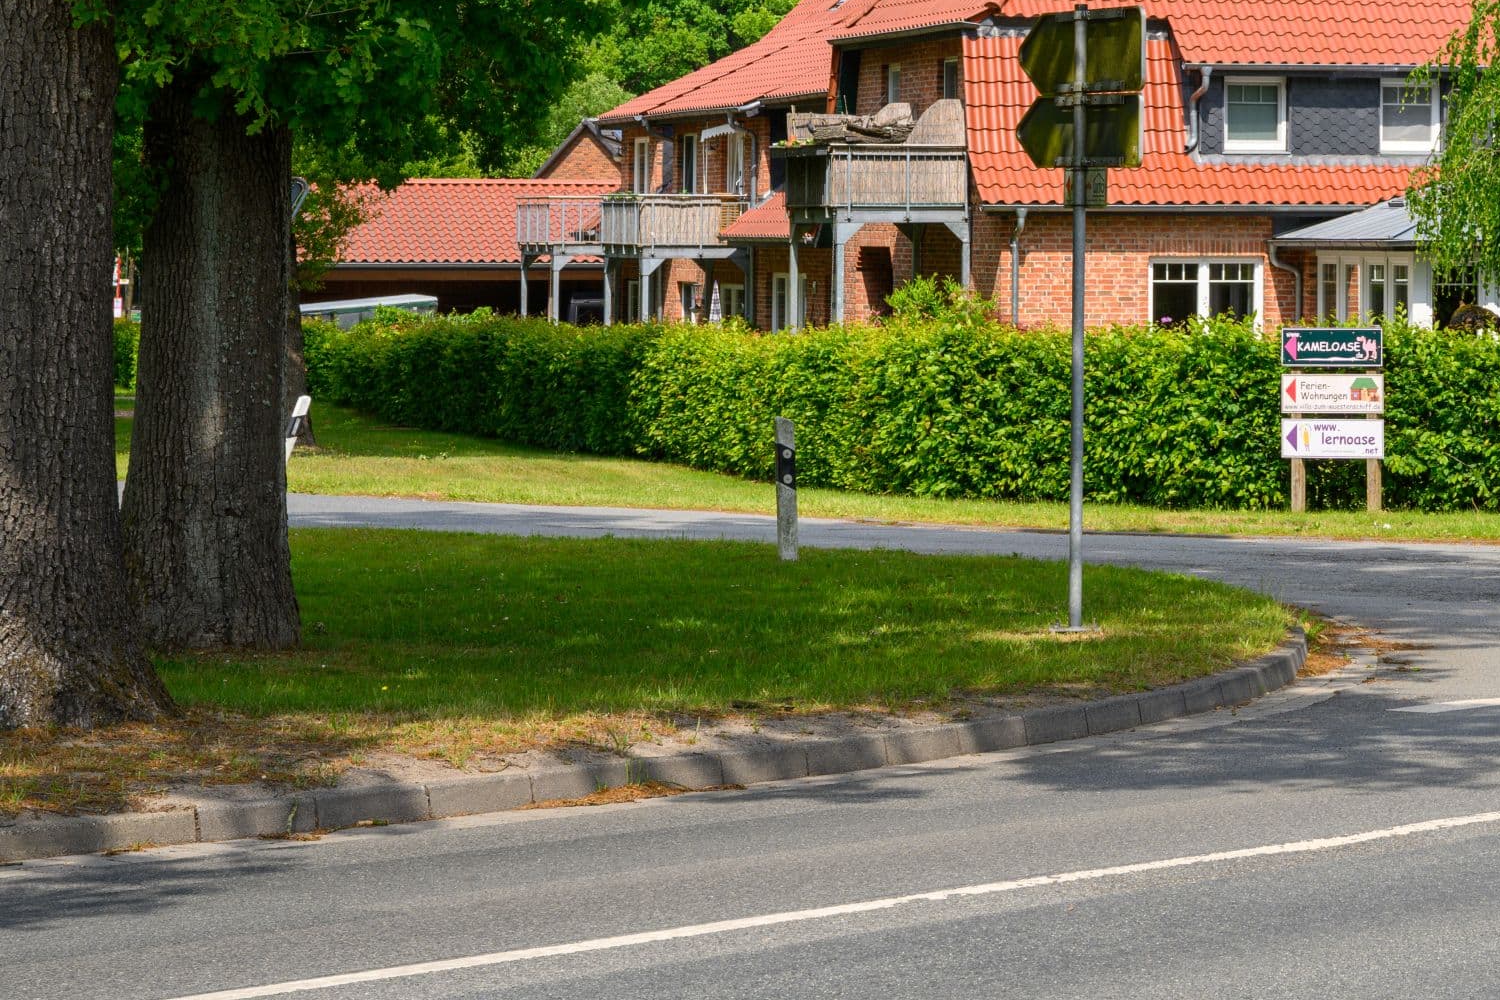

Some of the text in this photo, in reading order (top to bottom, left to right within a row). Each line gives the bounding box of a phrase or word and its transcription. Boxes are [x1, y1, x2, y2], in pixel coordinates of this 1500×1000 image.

[1297, 341, 1361, 352] KAMELOASE
[1300, 381, 1331, 390] Ferien-
[1300, 391, 1348, 402] Wohnungen
[1314, 424, 1341, 432] www.
[1321, 432, 1376, 445] lernoase
